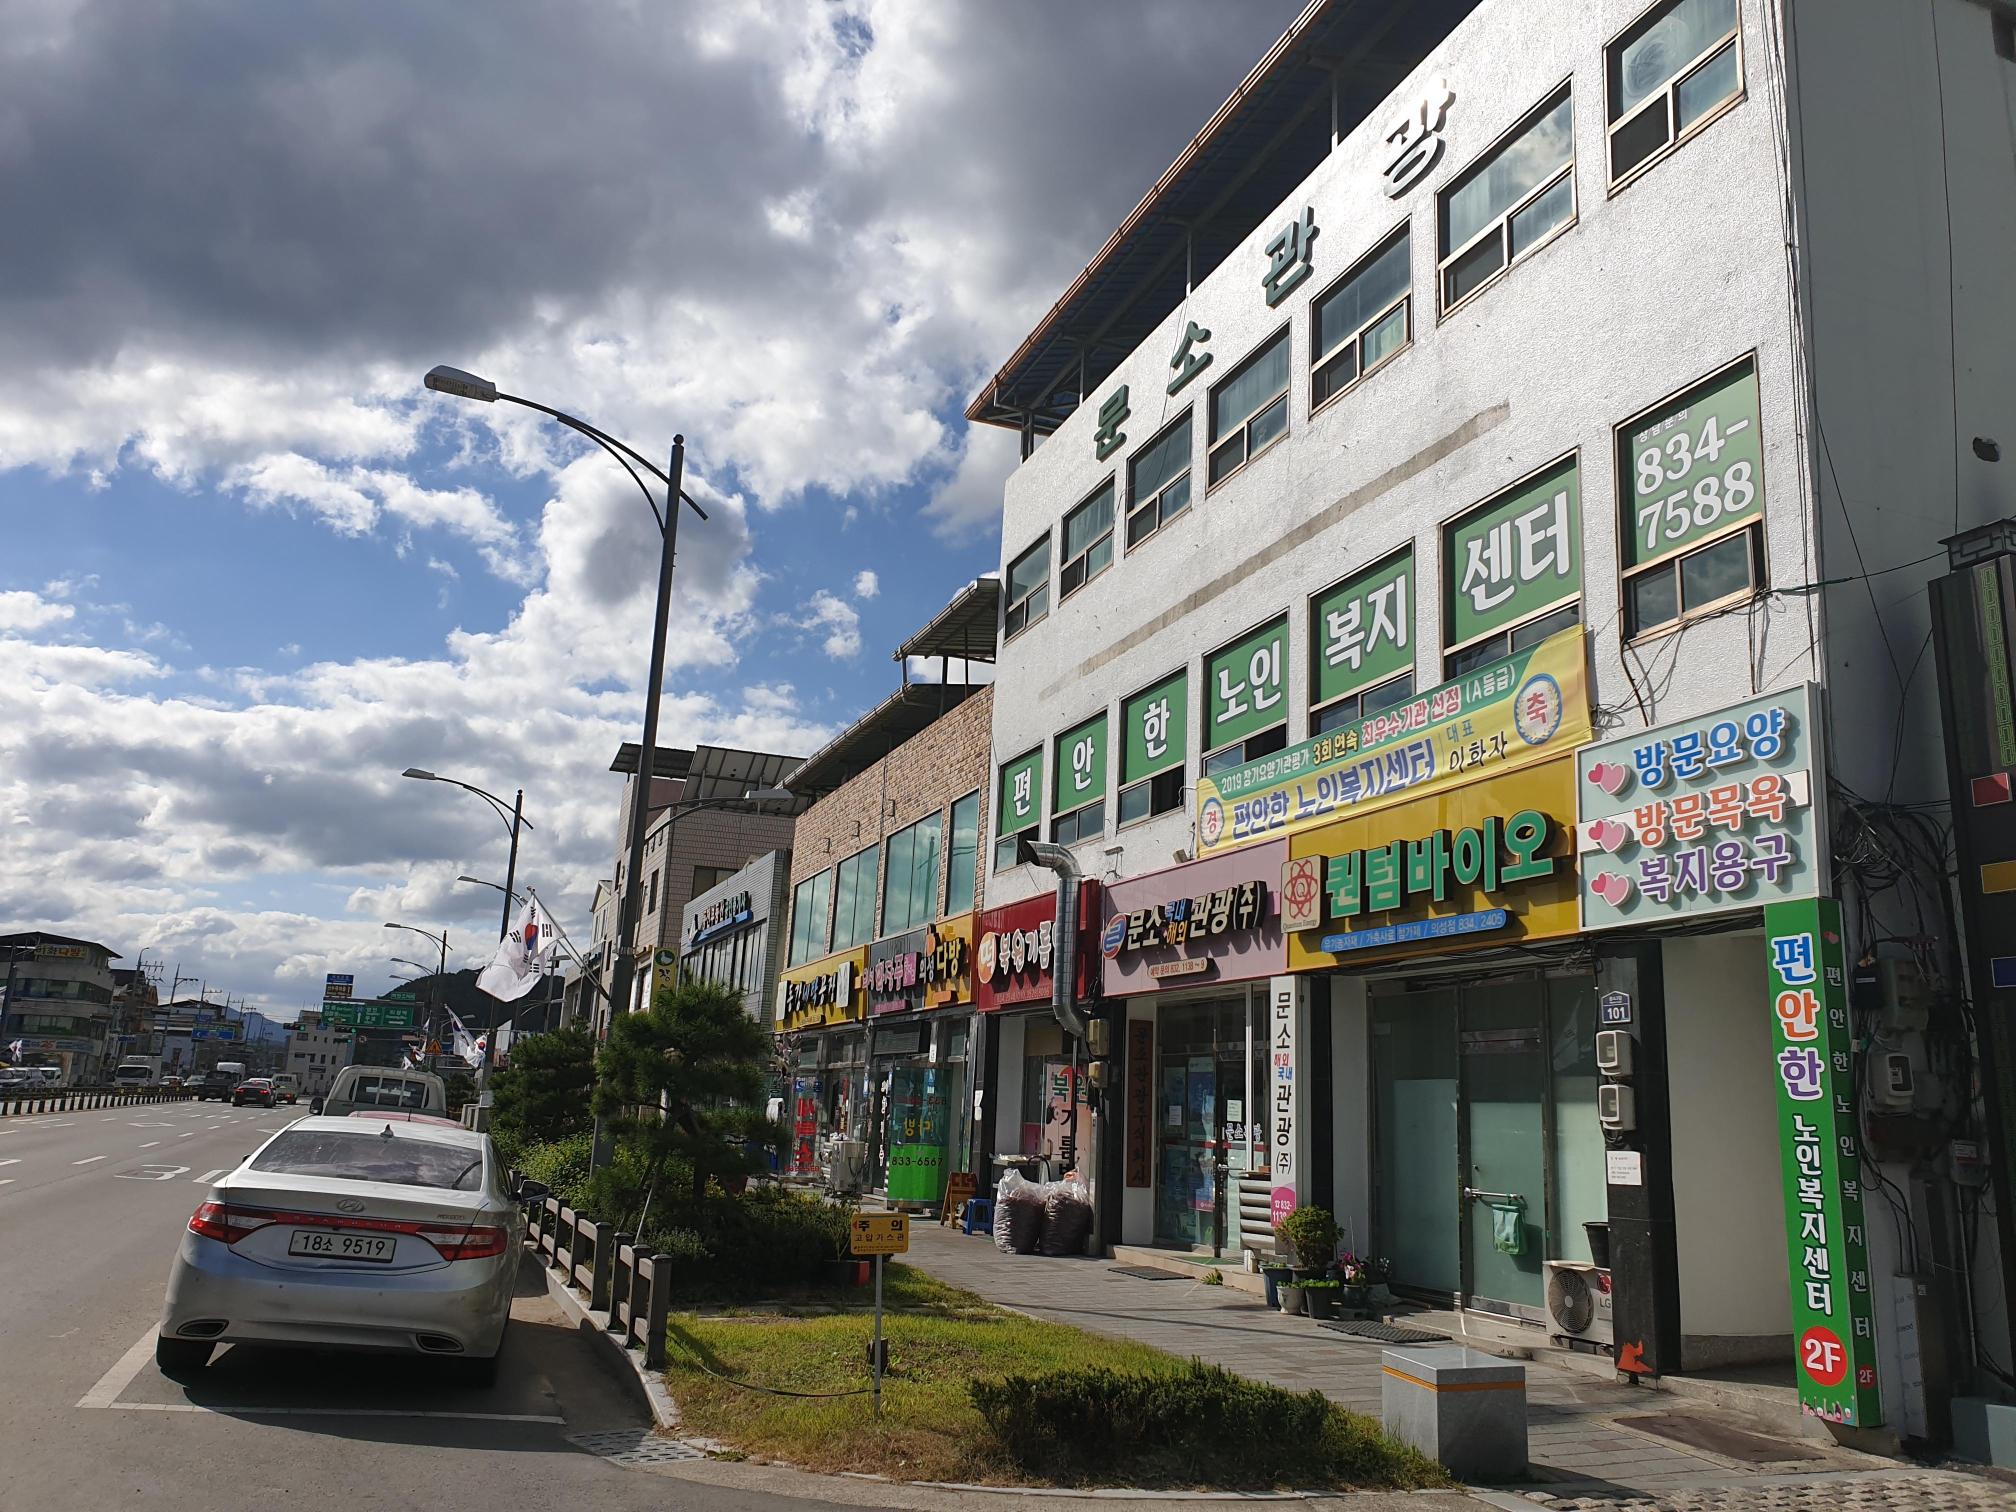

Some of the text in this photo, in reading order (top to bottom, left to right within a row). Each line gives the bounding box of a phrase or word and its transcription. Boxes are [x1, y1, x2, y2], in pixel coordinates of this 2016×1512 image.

[1637, 416, 1749, 495] 834-
[1638, 461, 1755, 549] 7588
[1221, 774, 1242, 794] 2019
[1243, 749, 1310, 787] 장기요양기관평가
[1431, 684, 1461, 722] 선정
[1466, 664, 1515, 704] (A등급)
[1527, 692, 1548, 724] 축
[1633, 706, 1784, 788] 방문요양
[1206, 810, 1218, 834] 경
[1232, 738, 1436, 840] 편안한 노인복지센터
[1633, 774, 1786, 847] 방문목욕
[1325, 809, 1554, 919] 퀀텀바이오
[1638, 833, 1790, 901] 복지용구
[999, 920, 1057, 976] 북원기름
[1607, 1007, 1626, 1020] 101
[1773, 934, 1824, 1100] 편안한
[892, 1156, 944, 1167] 833-6567
[303, 1235, 385, 1256] 18소 9519
[1793, 1114, 1832, 1316] 노인복지센터
[1600, 1298, 1612, 1309] LG
[1805, 1338, 1841, 1374] 2F
[1859, 1369, 1873, 1384] 2F
